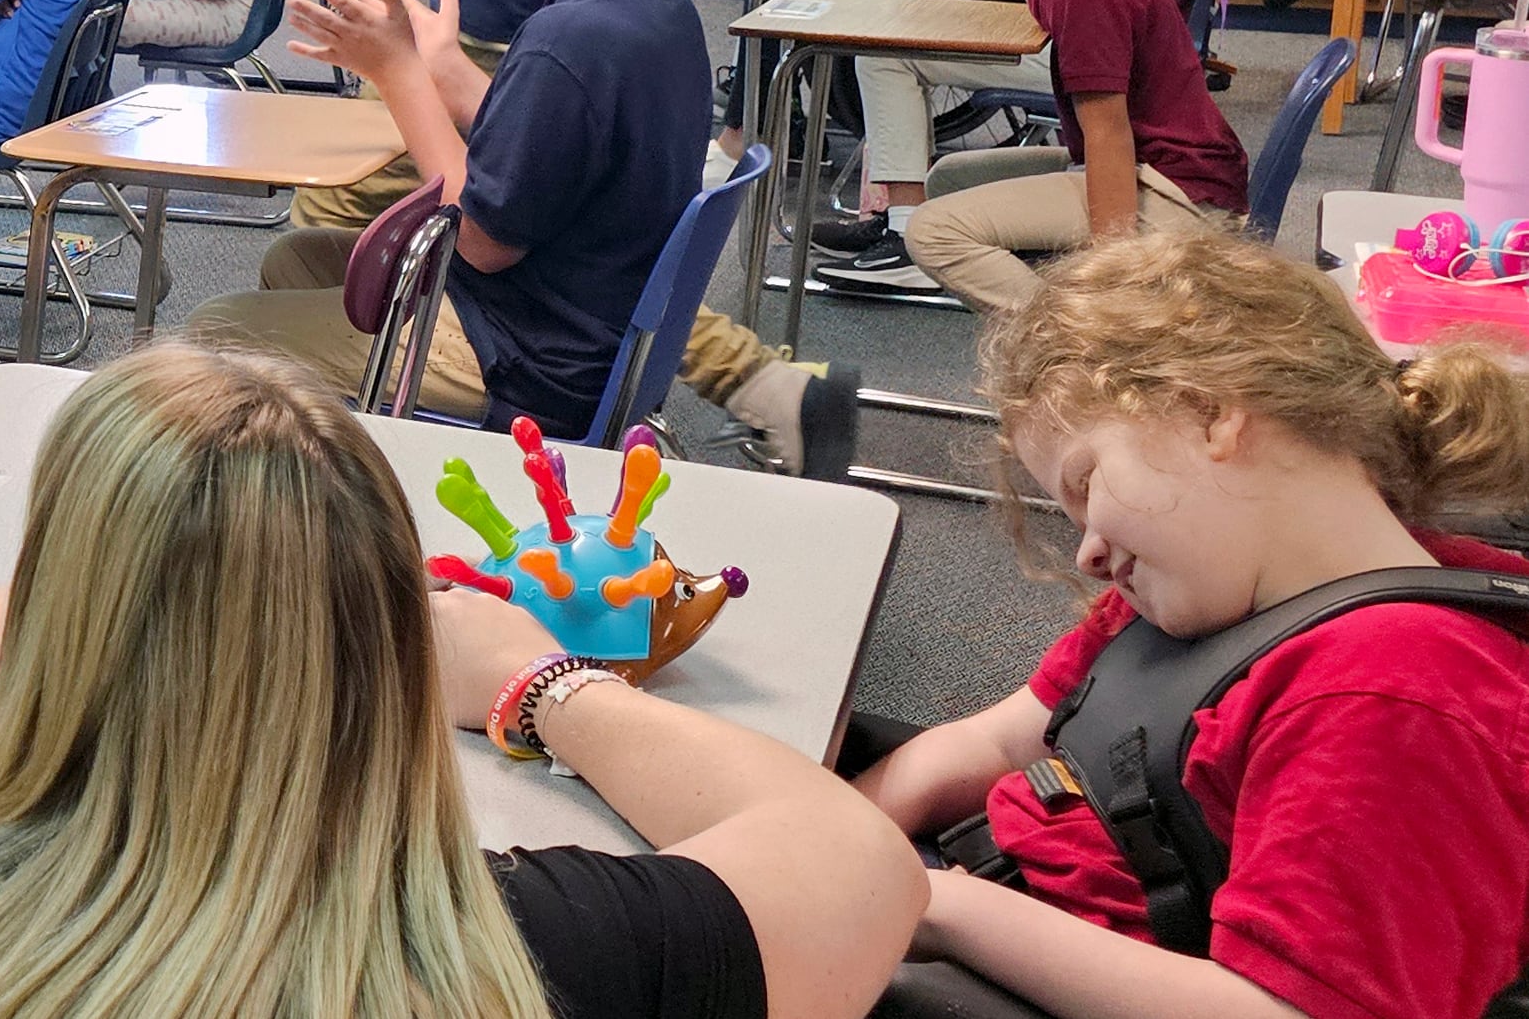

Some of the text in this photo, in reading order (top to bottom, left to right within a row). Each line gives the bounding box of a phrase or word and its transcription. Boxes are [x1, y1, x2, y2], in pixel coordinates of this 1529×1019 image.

[516, 664, 536, 681] Out
[506, 681, 518, 693] of
[494, 692, 509, 711] the
